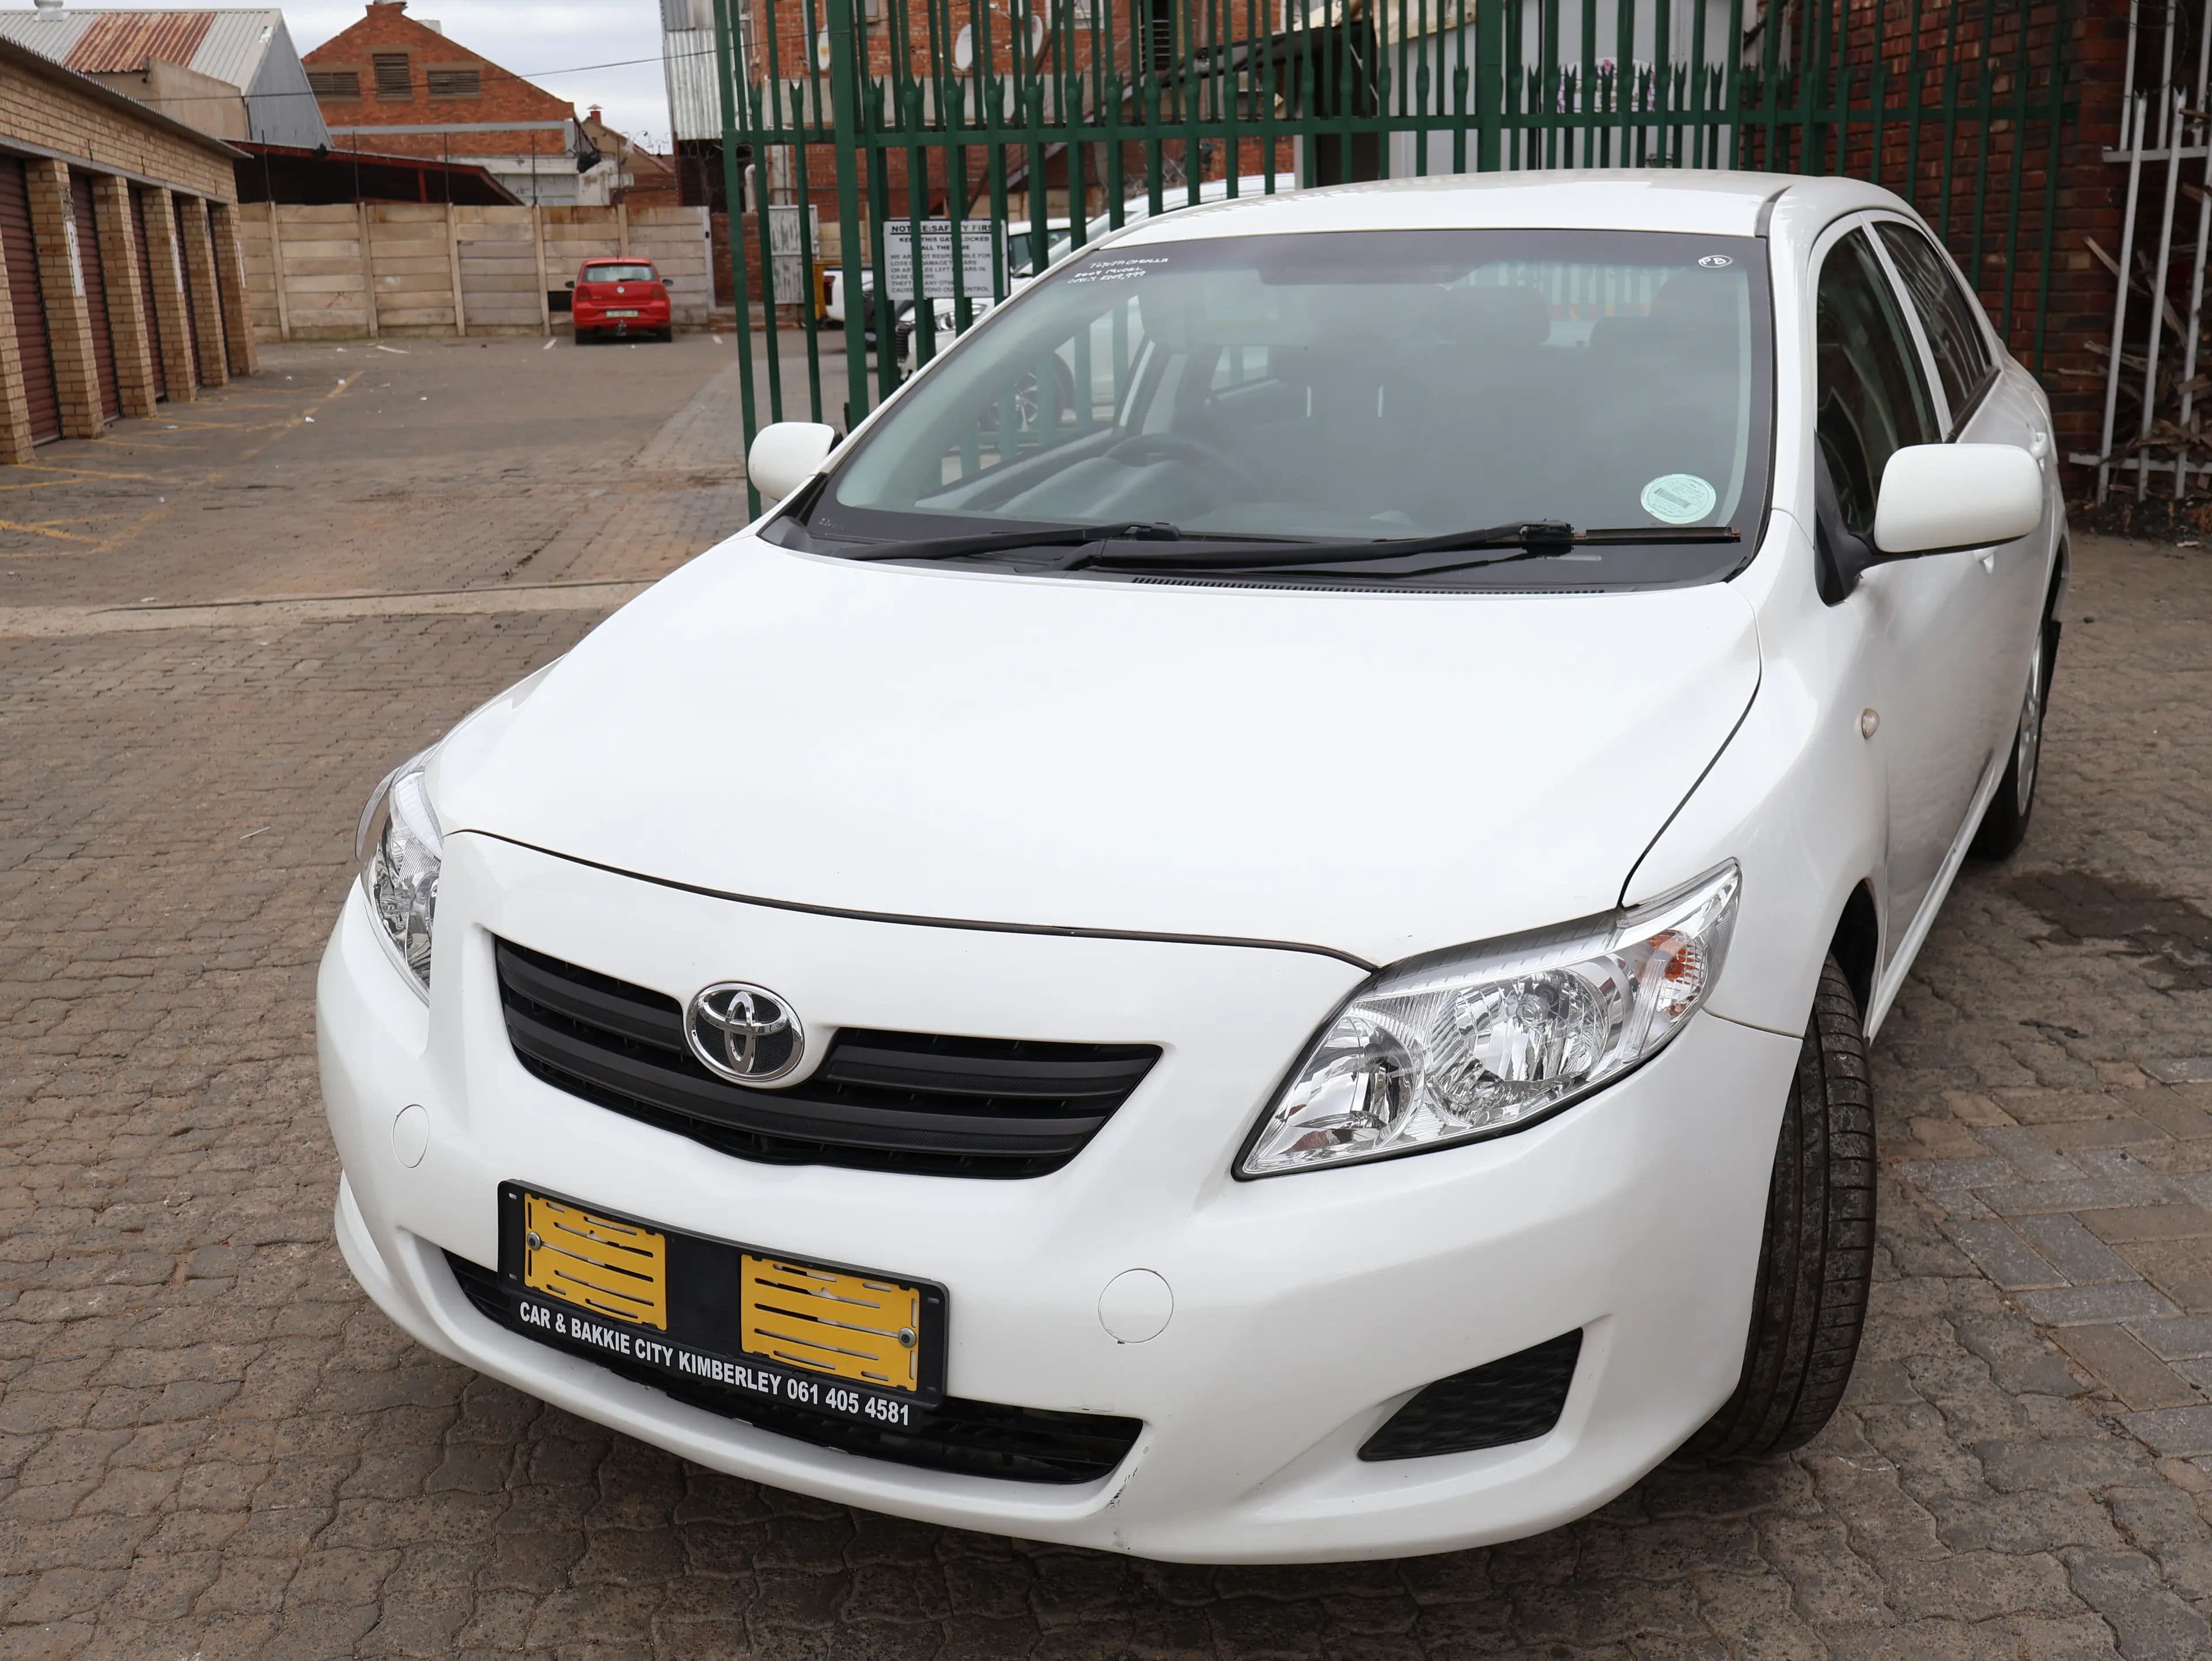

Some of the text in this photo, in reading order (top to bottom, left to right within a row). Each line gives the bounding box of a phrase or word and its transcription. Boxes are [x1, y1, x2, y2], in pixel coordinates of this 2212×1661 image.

[520, 1301, 908, 1426] CAR & BAKKIE CITY KIMBERLEY 061 405 4581
